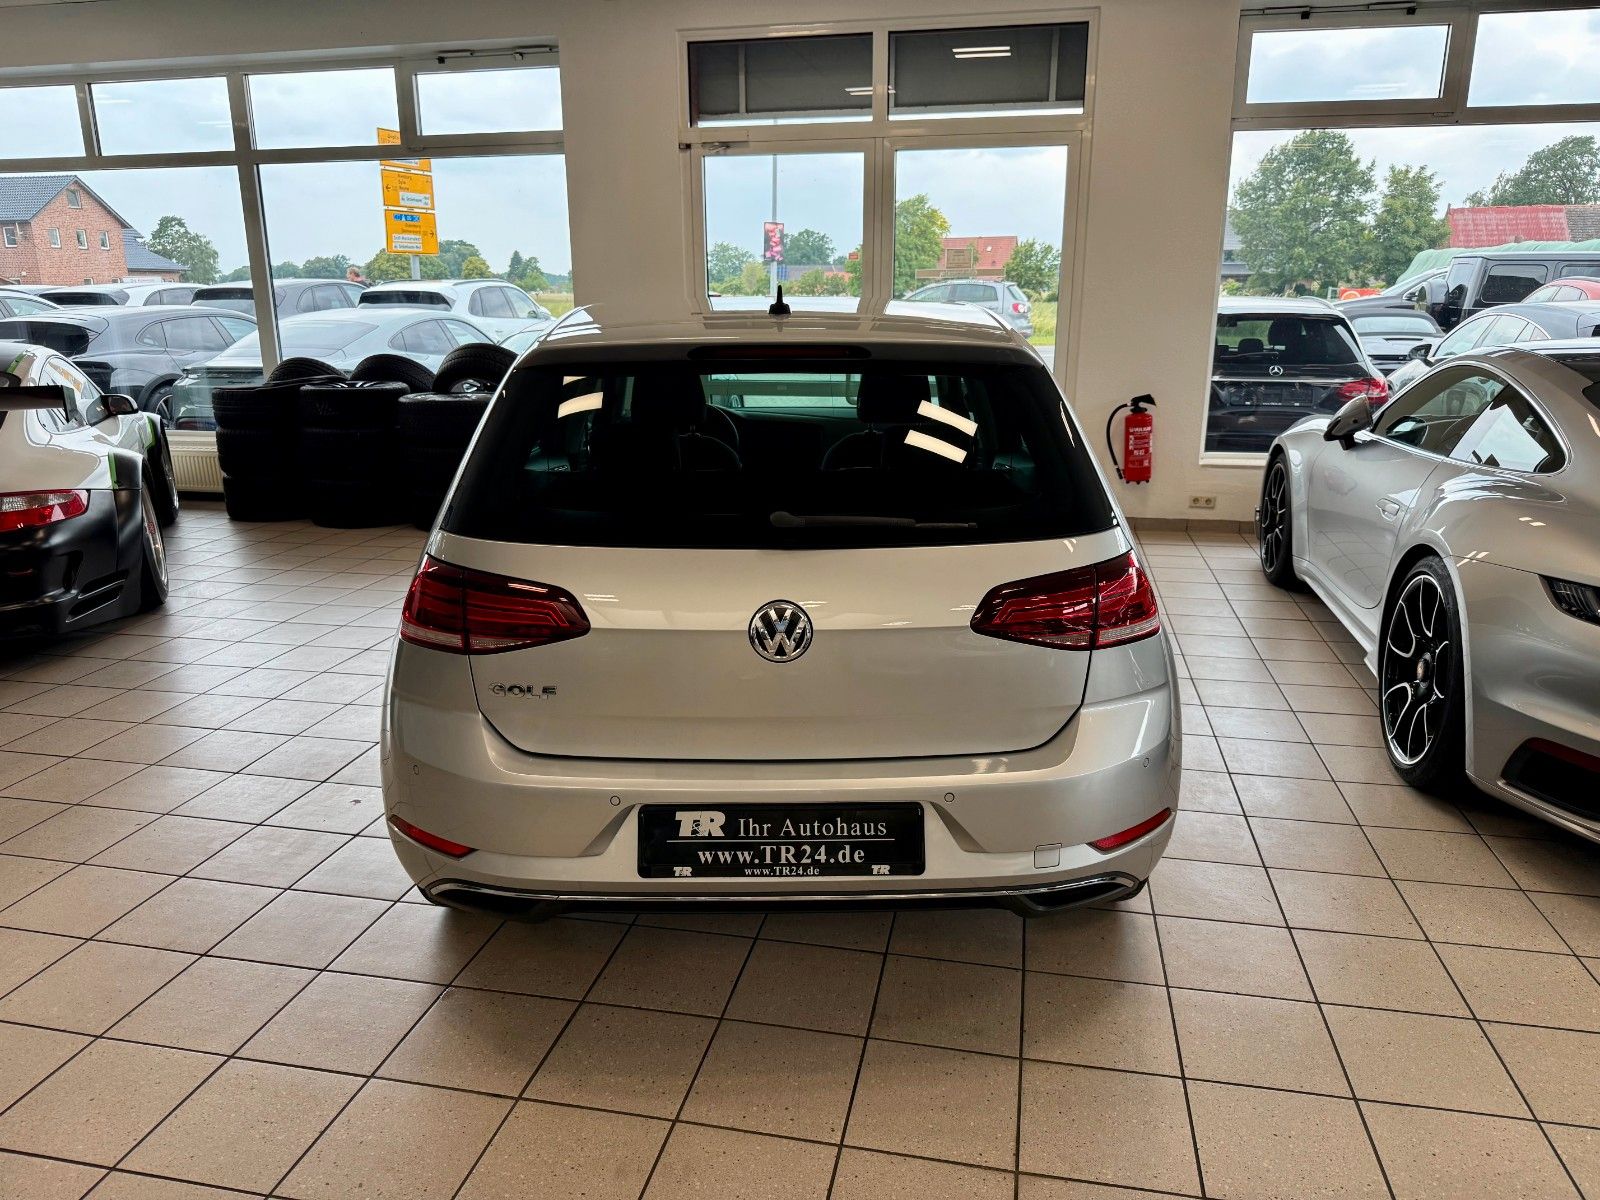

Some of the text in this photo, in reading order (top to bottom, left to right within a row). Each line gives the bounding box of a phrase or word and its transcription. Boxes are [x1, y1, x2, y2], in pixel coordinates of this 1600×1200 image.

[489, 682, 558, 700] GOLF
[738, 819, 771, 837] Ihr
[780, 817, 888, 836] Autohaus
[697, 844, 866, 864] www.TR24.de
[744, 866, 820, 876] www.TR24.de
